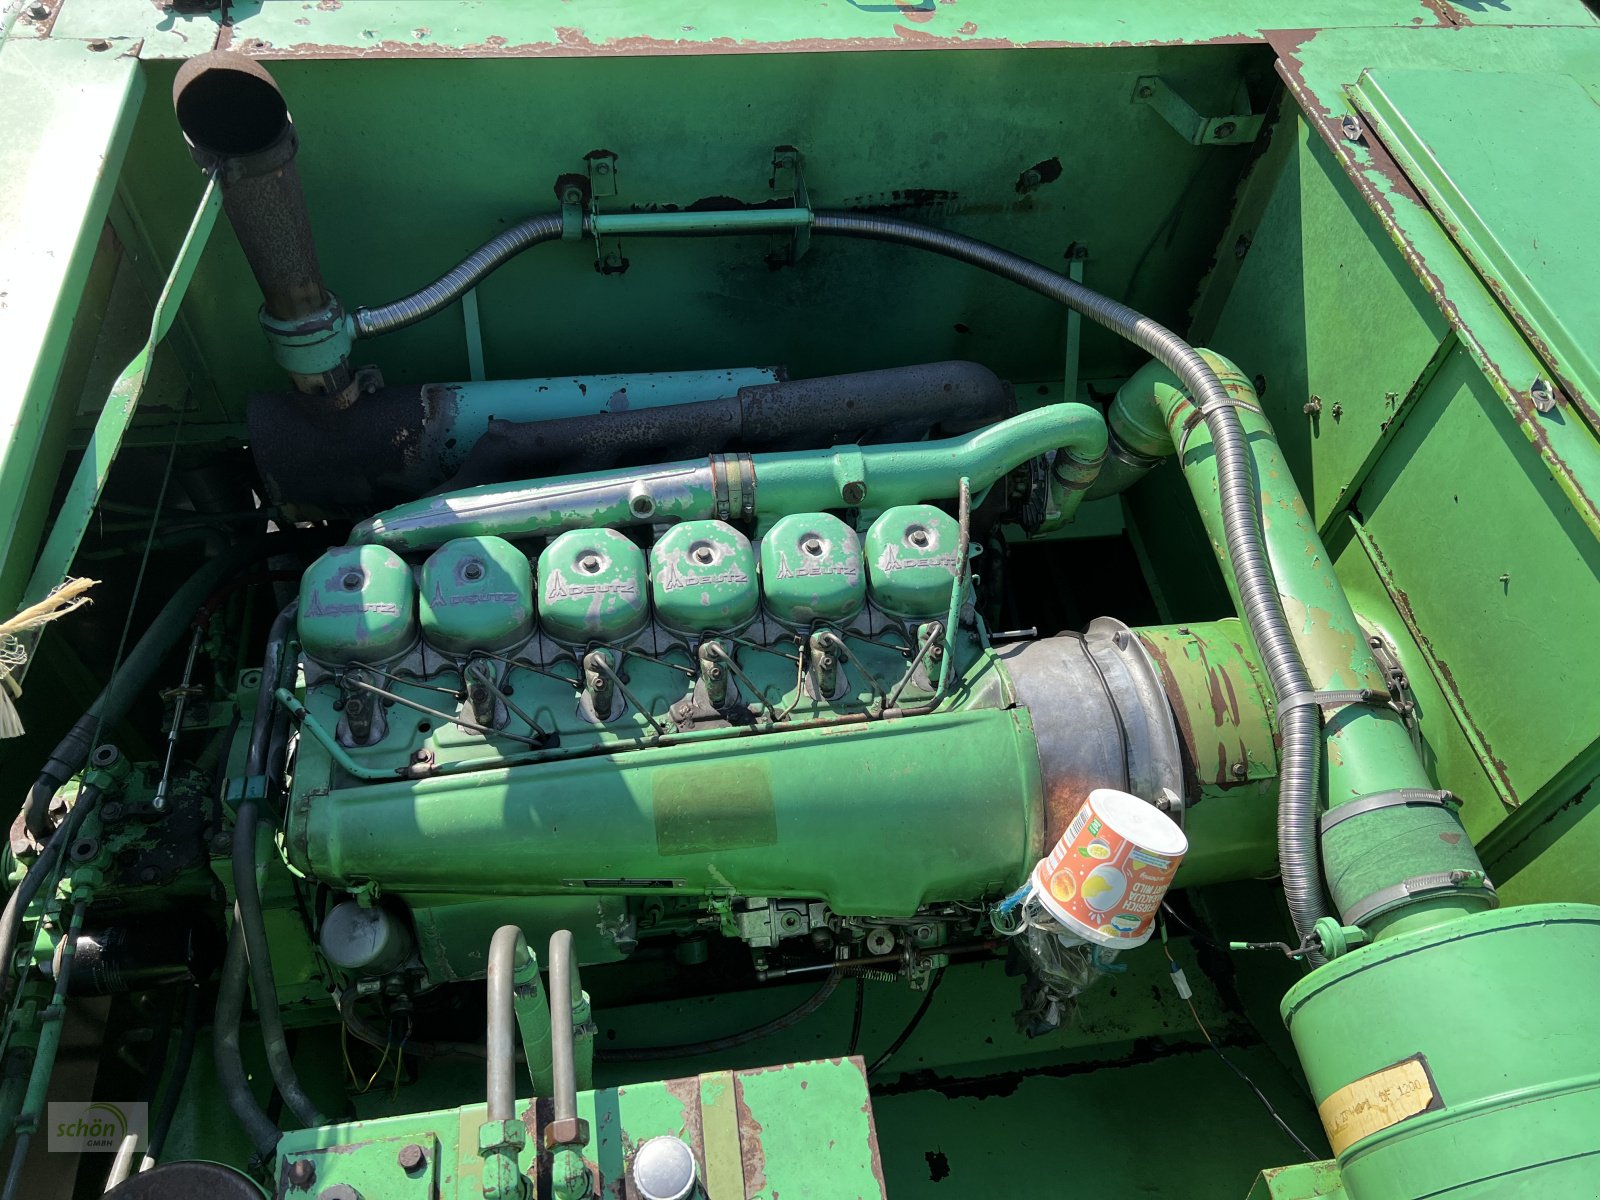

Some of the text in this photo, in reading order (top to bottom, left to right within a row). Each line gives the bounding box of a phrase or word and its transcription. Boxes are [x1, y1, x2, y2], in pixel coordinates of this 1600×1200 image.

[795, 565, 857, 577] DEUTZ
[684, 573, 748, 587] DEUTZ
[568, 583, 636, 595] DEUTZ
